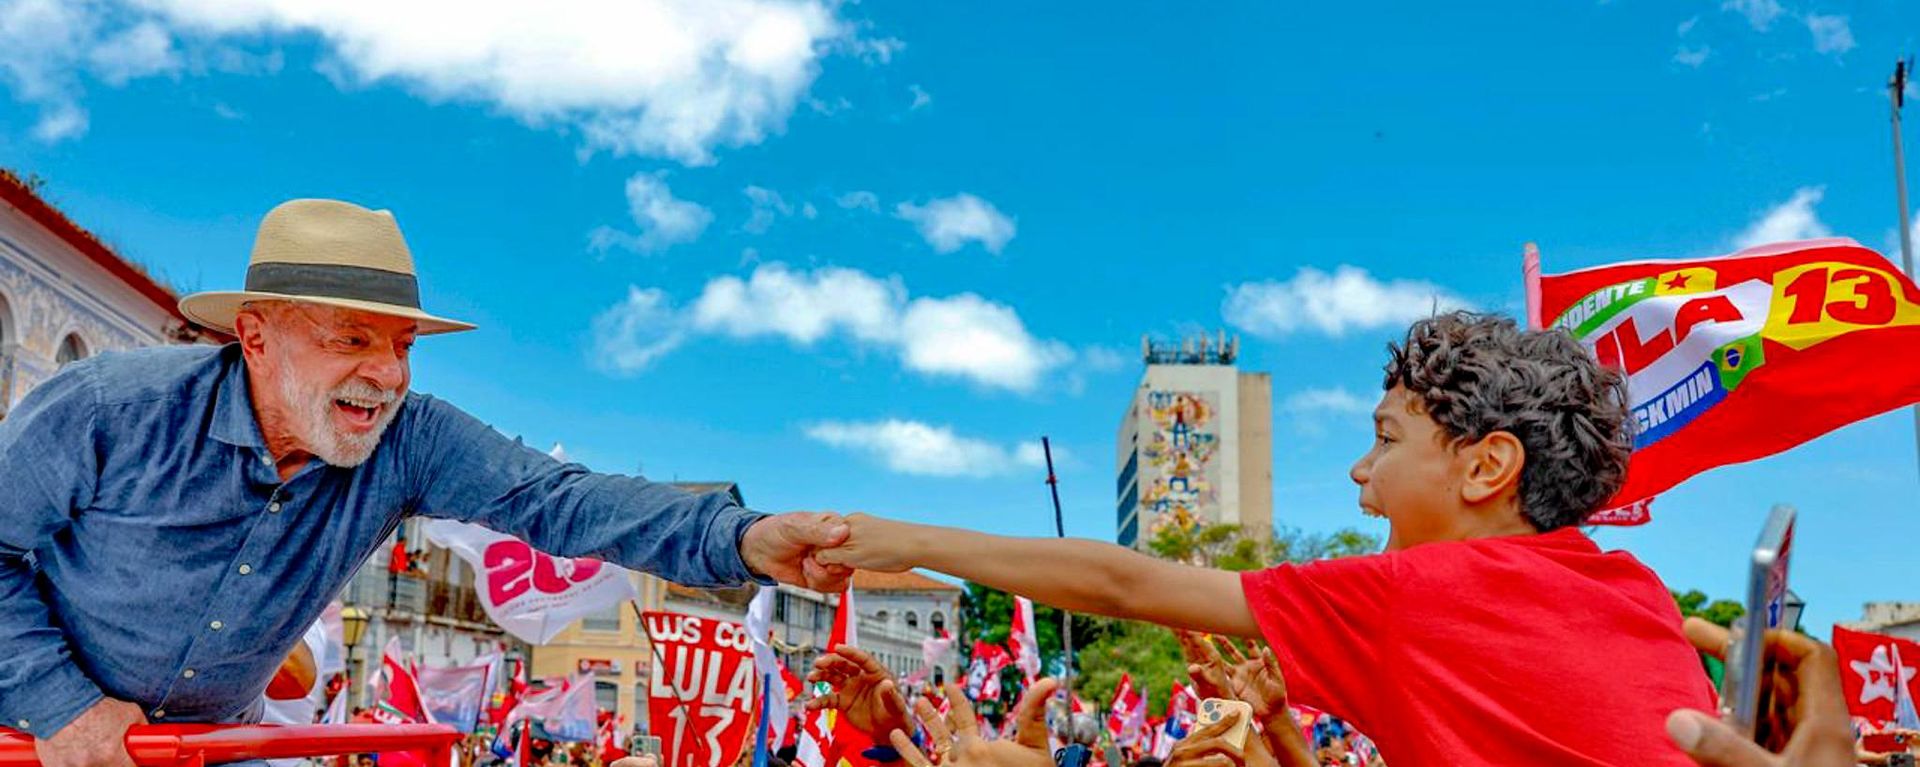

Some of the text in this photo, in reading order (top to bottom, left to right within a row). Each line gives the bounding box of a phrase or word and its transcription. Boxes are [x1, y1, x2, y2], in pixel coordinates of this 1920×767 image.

[1784, 267, 1897, 325] 13
[650, 642, 753, 713] LULA
[667, 703, 735, 767] 13
